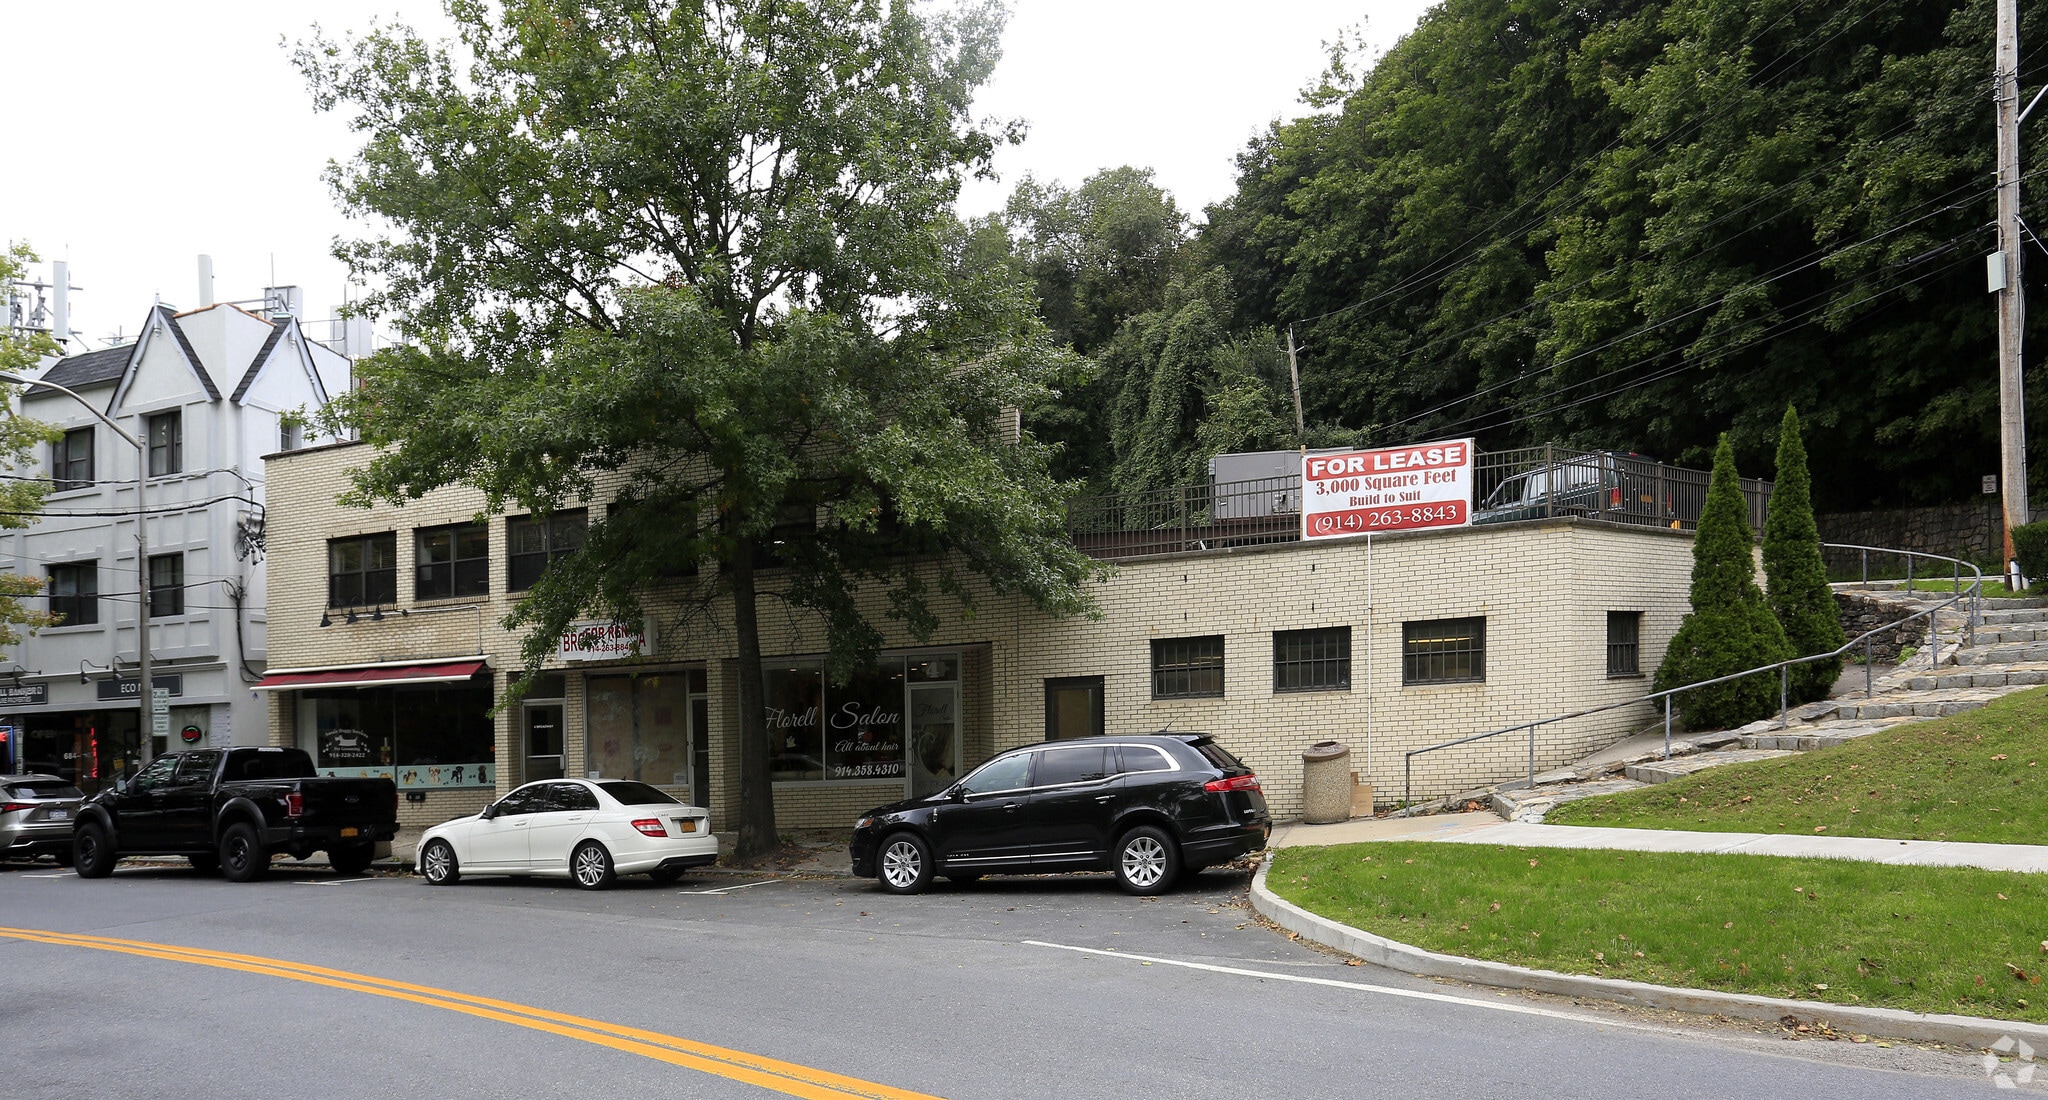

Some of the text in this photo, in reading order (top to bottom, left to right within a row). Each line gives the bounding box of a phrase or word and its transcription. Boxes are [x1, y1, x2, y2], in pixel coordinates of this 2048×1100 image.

[1311, 446, 1462, 477] FOR LEASE
[1315, 468, 1457, 497] 3,000 Square Feet
[1349, 490, 1421, 507] Build to Suit
[1315, 505, 1457, 534] (914) 263-8843
[121, 683, 136, 693] ECO
[765, 701, 900, 729] Florell Salon
[835, 740, 899, 752] All about hair
[835, 763, 899, 777] 914.358.4310
